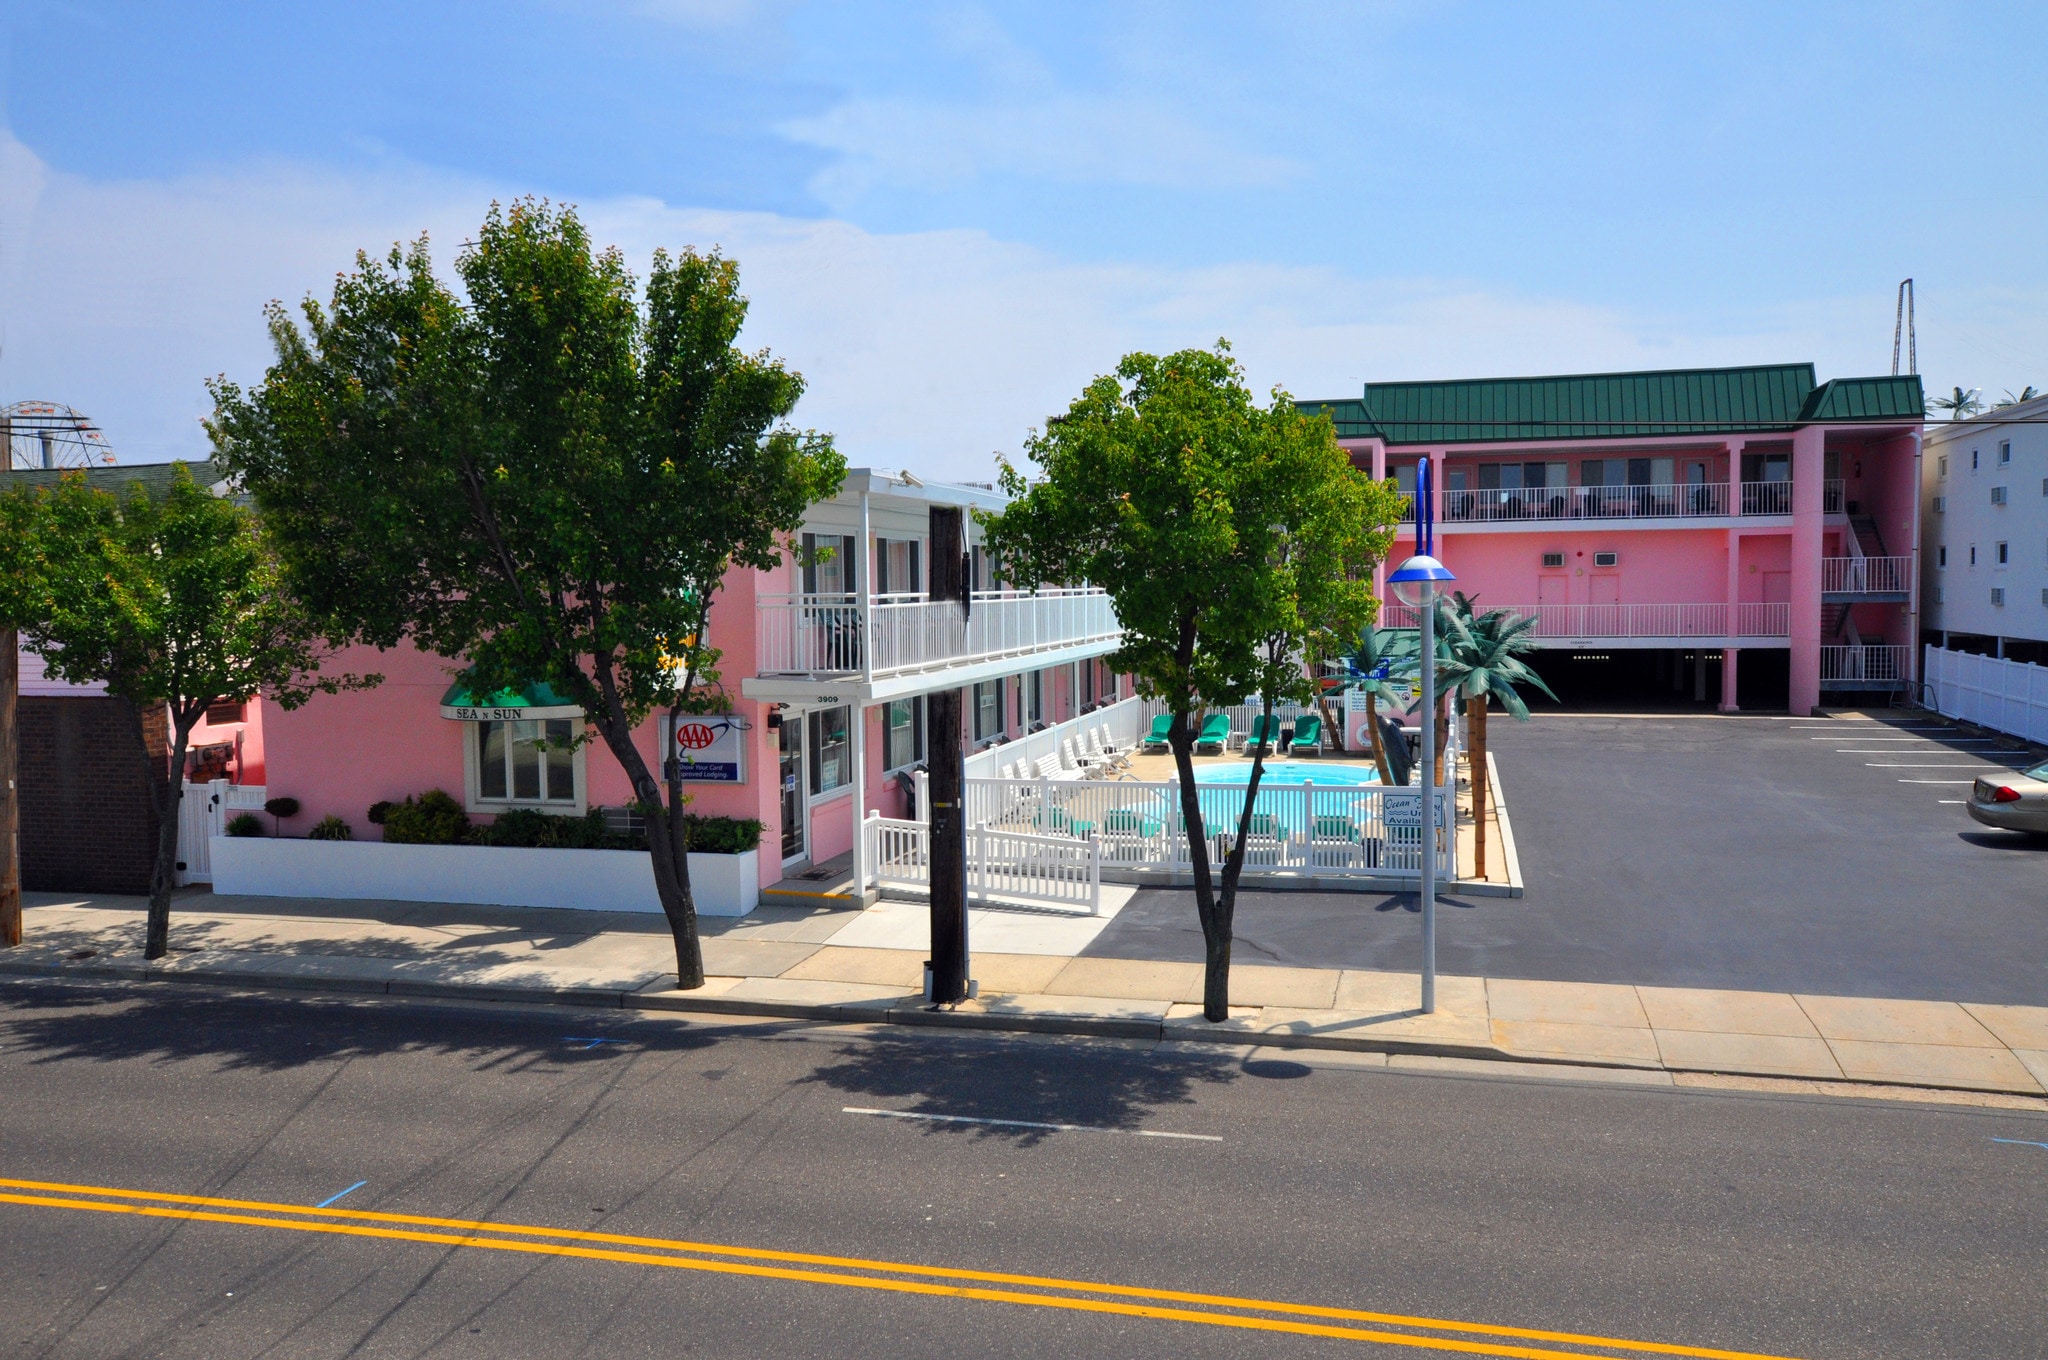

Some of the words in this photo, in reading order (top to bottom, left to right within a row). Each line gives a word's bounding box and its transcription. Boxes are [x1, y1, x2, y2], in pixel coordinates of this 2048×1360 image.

[457, 708, 478, 719] SEA
[494, 709, 521, 719] SUN
[680, 724, 711, 749] AAA
[1385, 798, 1410, 809] Ocean
